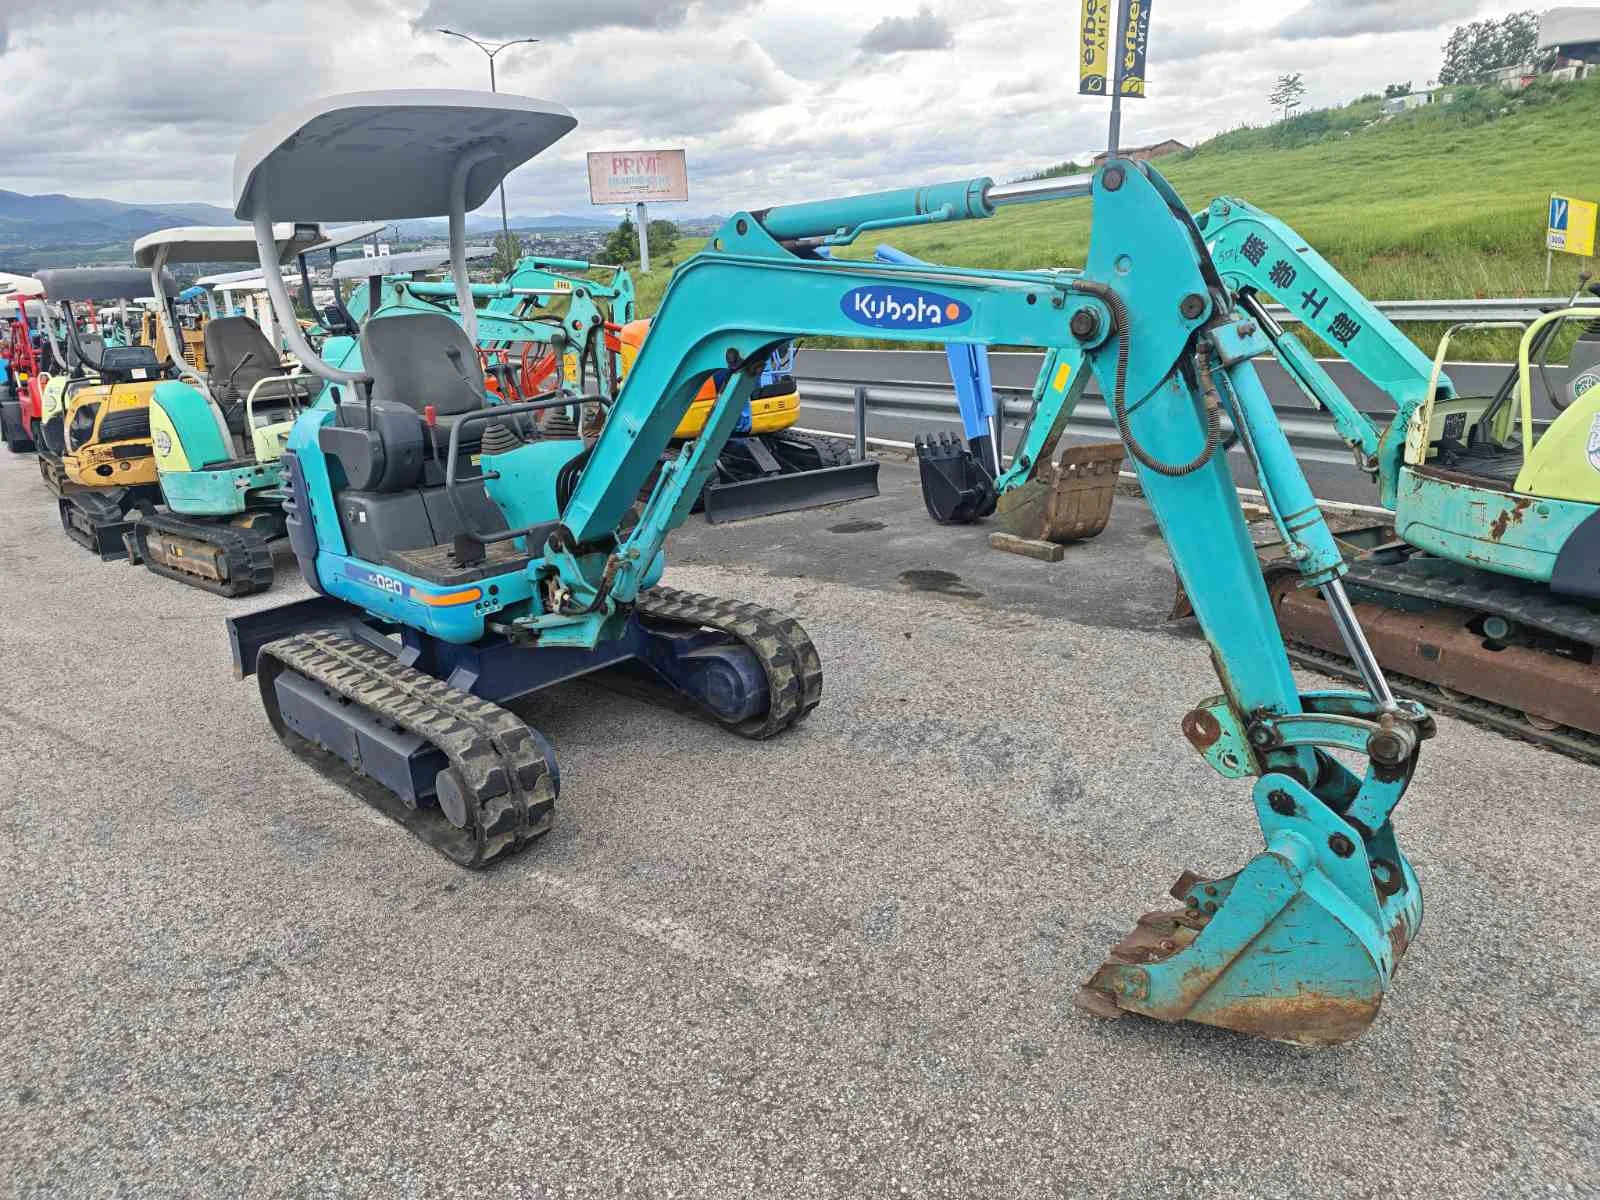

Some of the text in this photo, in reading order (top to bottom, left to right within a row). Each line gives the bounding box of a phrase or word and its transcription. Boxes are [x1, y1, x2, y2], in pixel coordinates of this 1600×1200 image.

[1124, 0, 1140, 71] efbe
[1137, 9, 1148, 55] ЛИГА
[855, 292, 941, 324] Kubota
